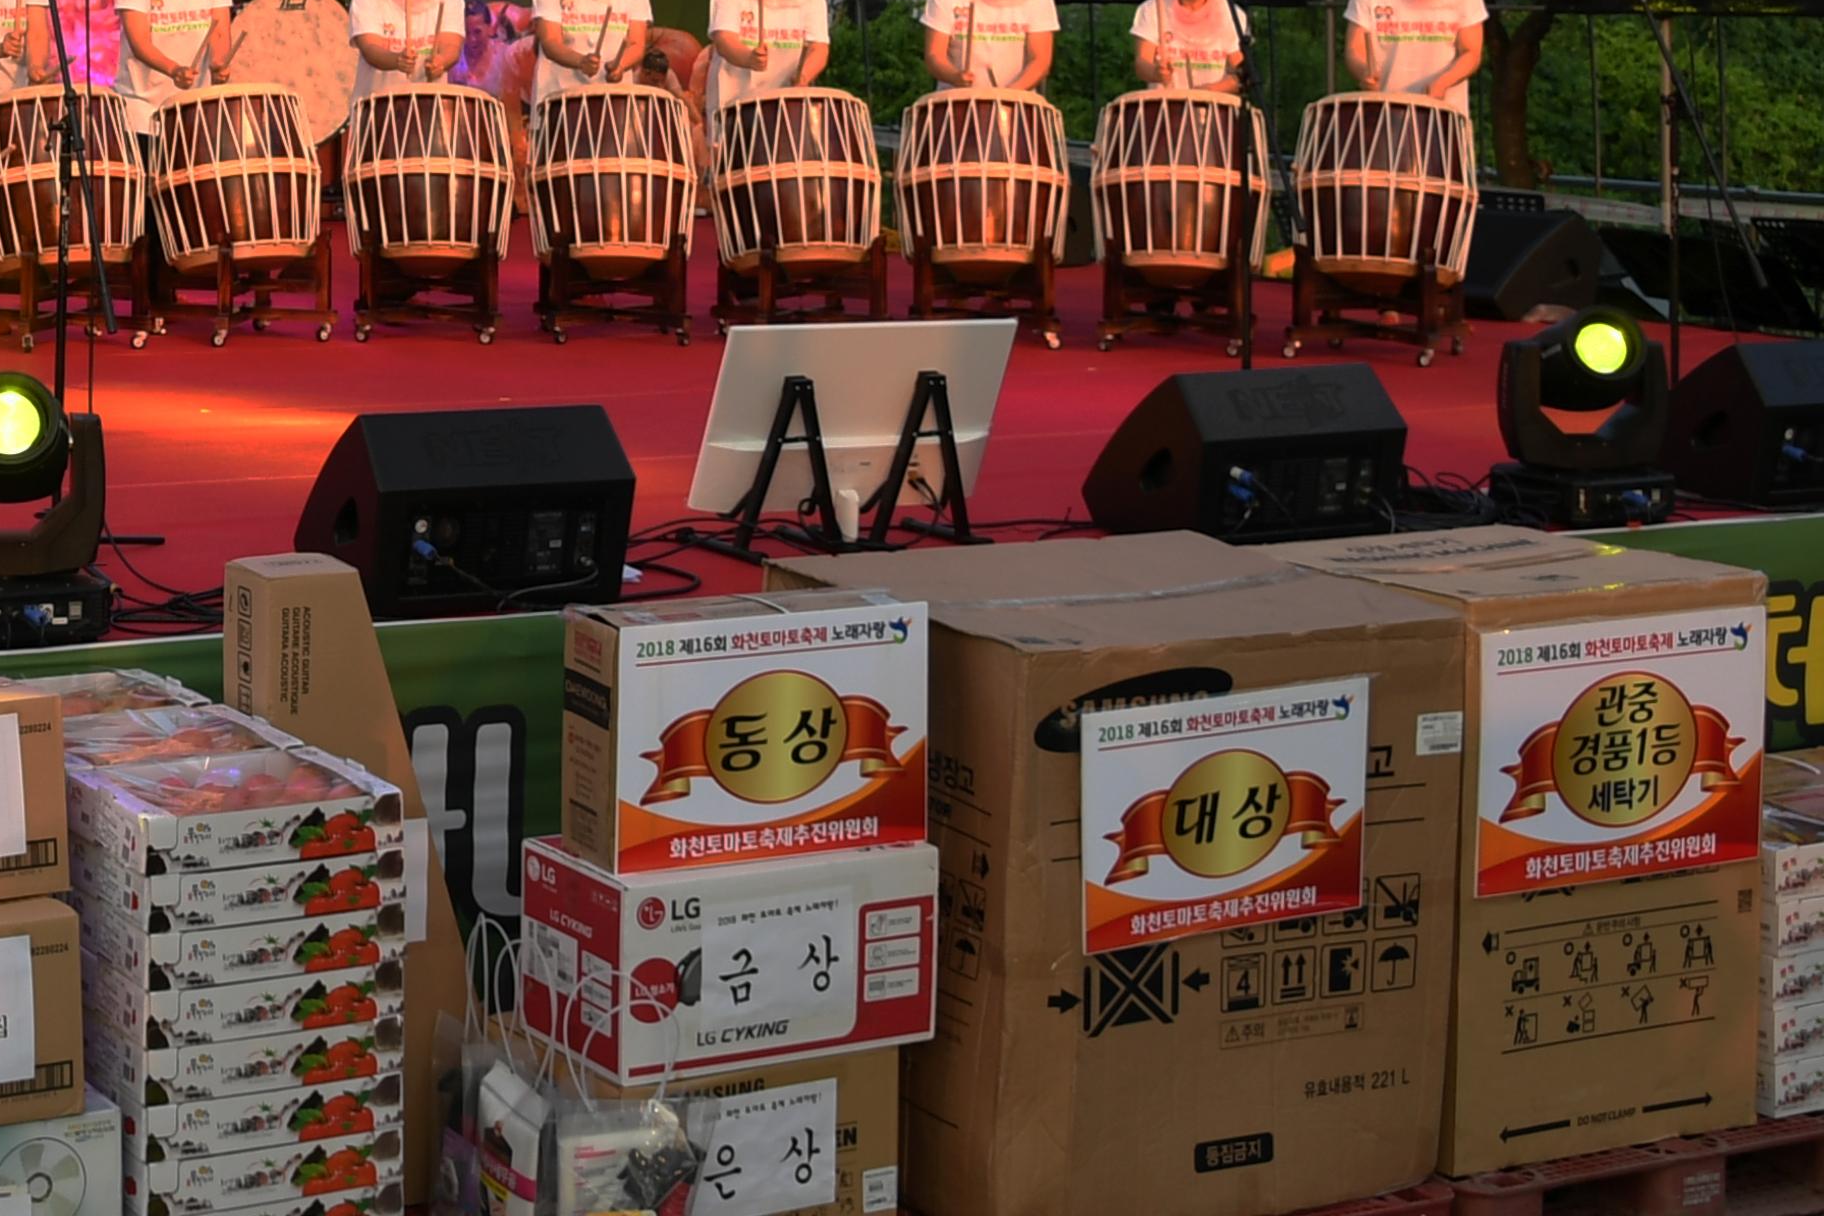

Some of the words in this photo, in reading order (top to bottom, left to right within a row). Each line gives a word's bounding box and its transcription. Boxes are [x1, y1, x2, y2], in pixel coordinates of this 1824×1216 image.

[636, 639, 675, 658] 2018
[679, 636, 727, 655] 제16회
[731, 626, 828, 651] 화천토마토축제
[831, 620, 886, 642] 노래자랑
[1497, 647, 1534, 666] 2018
[1537, 642, 1582, 663] 제16회
[1584, 633, 1674, 658] 화천토마토축제
[1677, 626, 1728, 648] 노래자랑
[1097, 724, 1135, 743] 2018
[1138, 718, 1183, 738] 제16회
[1186, 706, 1276, 732] 화천토마토축제
[1279, 698, 1330, 721] 노래자랑
[1594, 681, 1659, 728] 관중
[1569, 723, 1681, 776] 경품1등
[1587, 773, 1659, 813] 세탁기
[669, 816, 879, 860] 화천토마토축제추진위원회
[1525, 833, 1717, 881] 화천토마토축제추진위원회
[541, 862, 557, 885] LG
[671, 896, 701, 921] LG
[1129, 885, 1318, 937] 화천토마토축제추진위원회
[696, 1030, 717, 1047] LG
[720, 1018, 790, 1042] CYKING
[1371, 1070, 1396, 1089] 221
